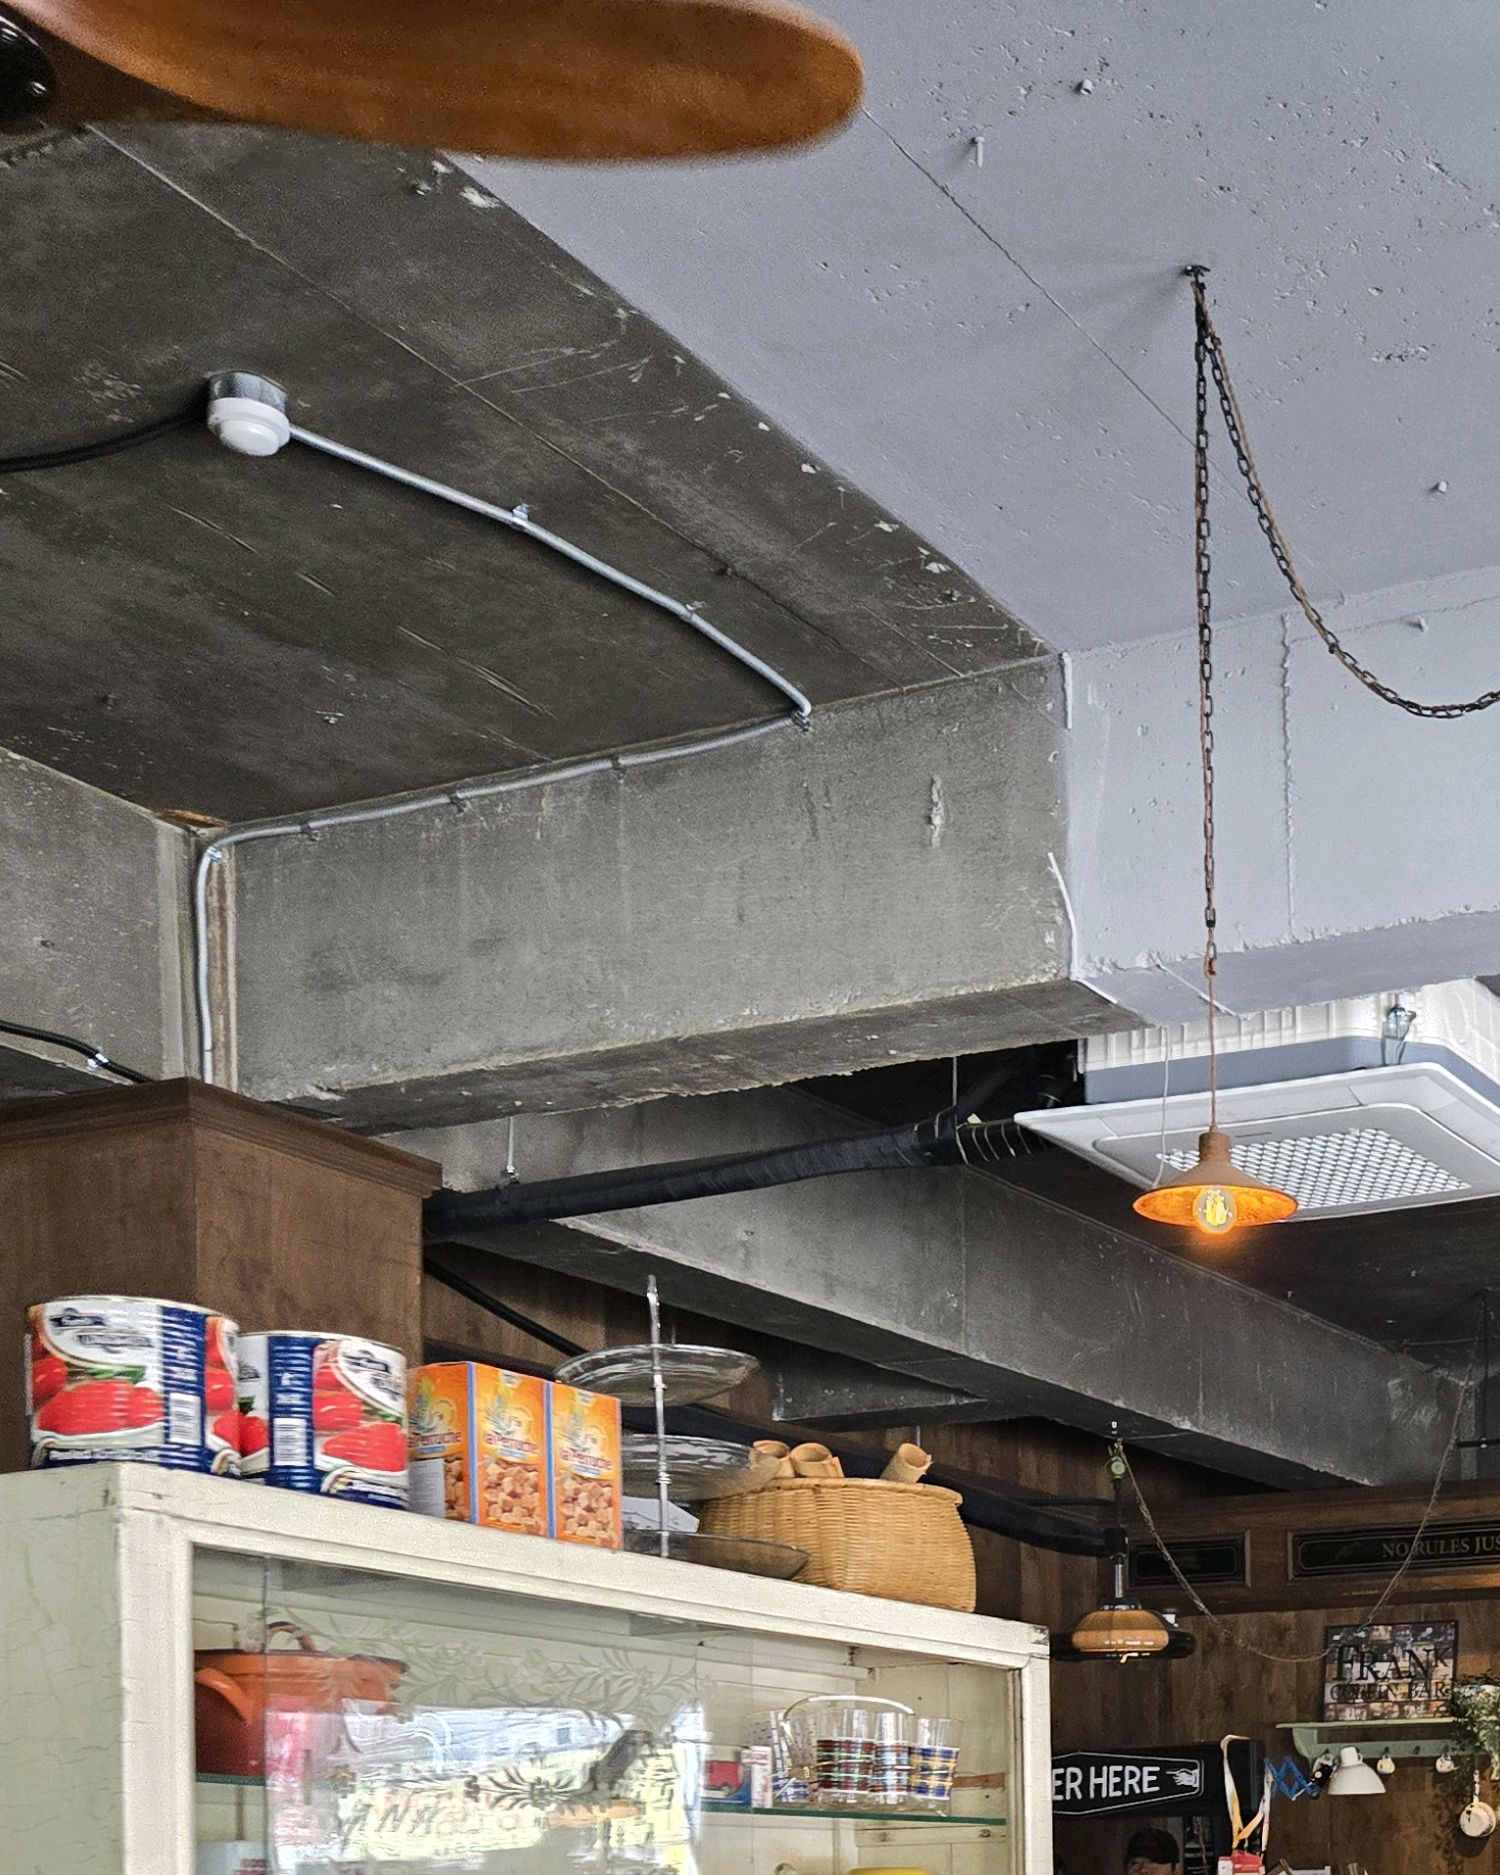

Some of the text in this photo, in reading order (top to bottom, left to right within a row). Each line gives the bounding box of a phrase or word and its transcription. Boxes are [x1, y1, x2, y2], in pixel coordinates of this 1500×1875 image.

[1382, 1540, 1408, 1558] NO
[1411, 1538, 1470, 1556] RULES
[1331, 1643, 1450, 1682] FRANK
[1089, 1765, 1161, 1799] HERE
